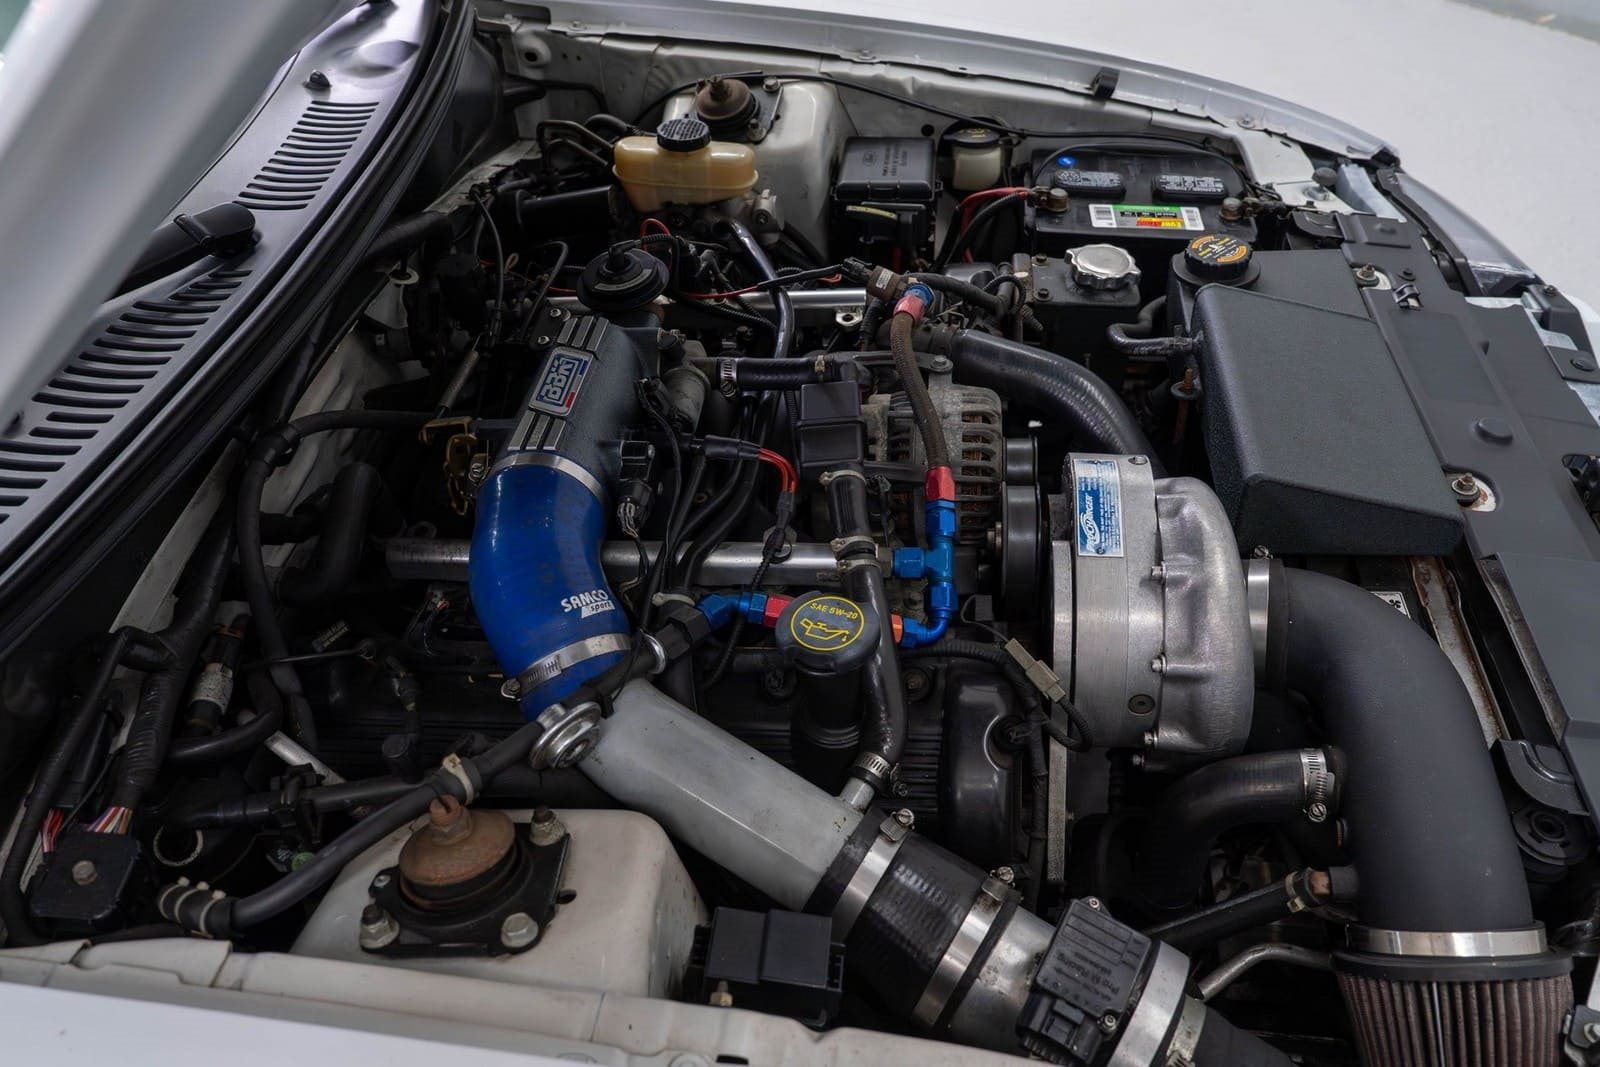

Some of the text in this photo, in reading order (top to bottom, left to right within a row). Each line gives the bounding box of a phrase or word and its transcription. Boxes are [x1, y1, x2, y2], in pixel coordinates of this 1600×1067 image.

[540, 358, 576, 400] BBK
[560, 589, 609, 613] SAMCO
[590, 601, 612, 612] sport
[810, 602, 858, 619] SAE 5W-20
